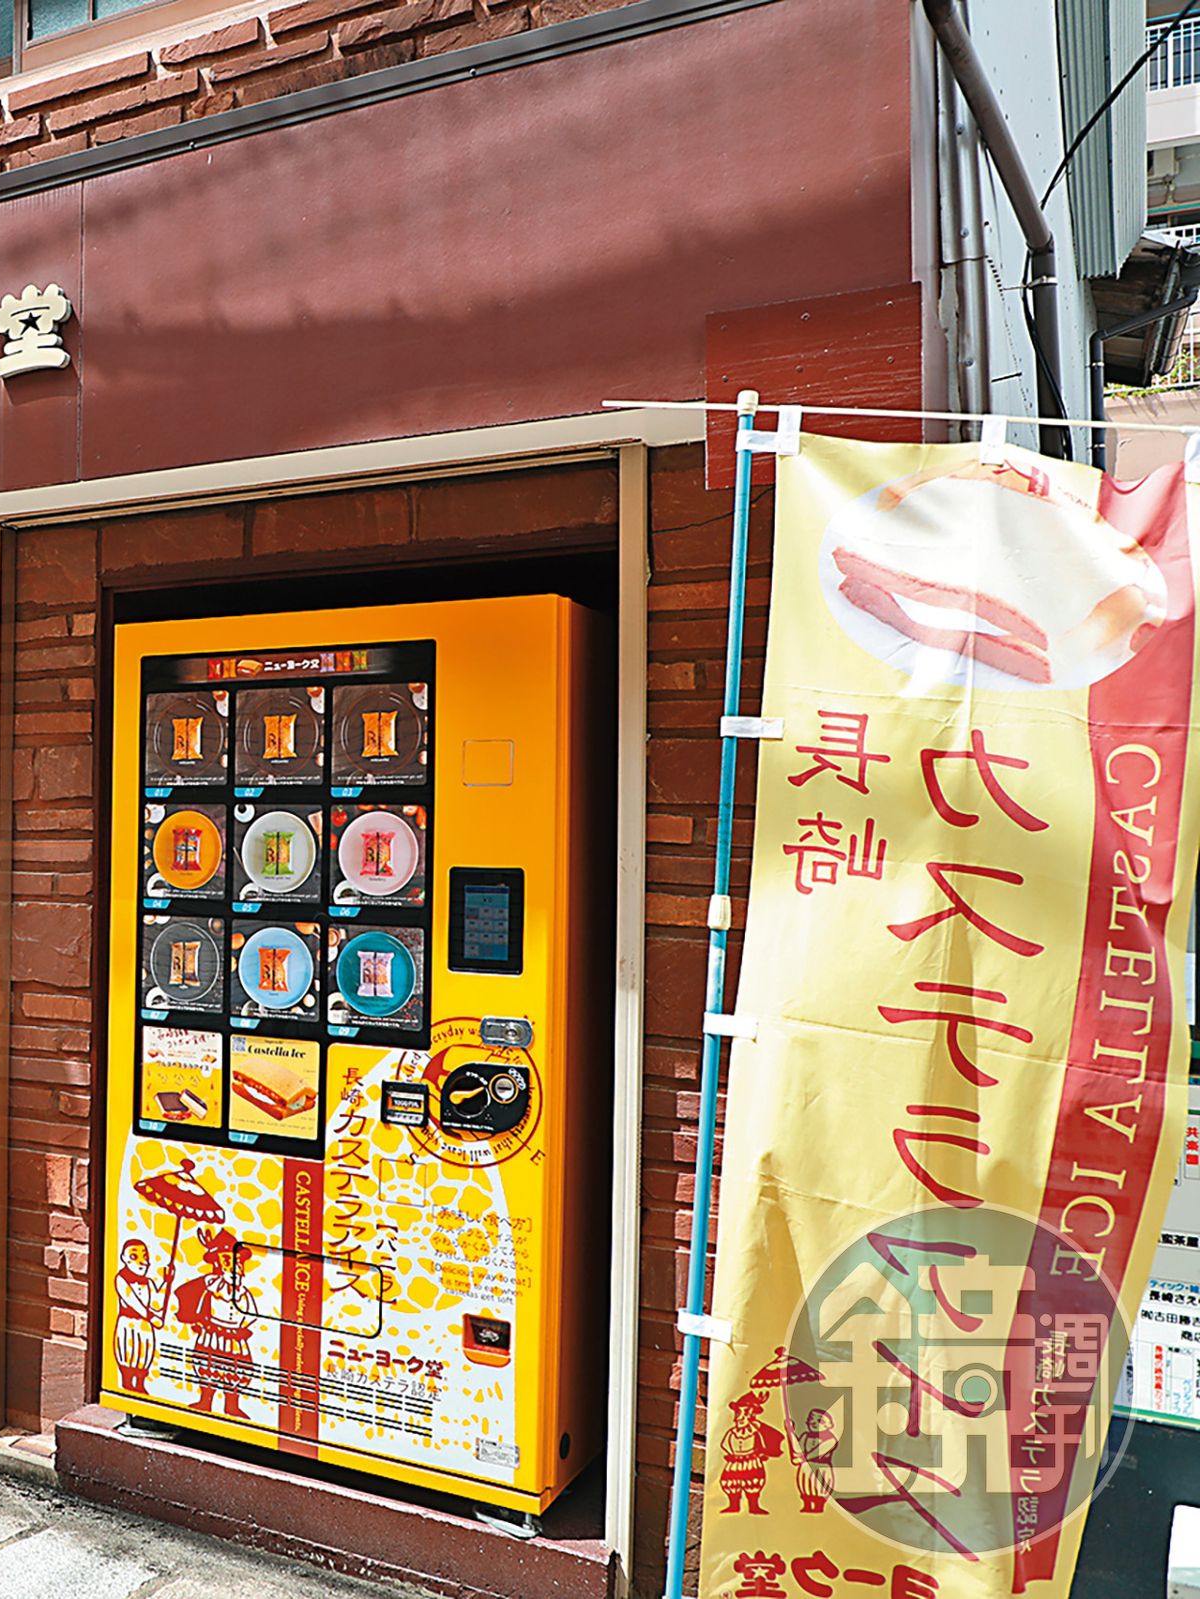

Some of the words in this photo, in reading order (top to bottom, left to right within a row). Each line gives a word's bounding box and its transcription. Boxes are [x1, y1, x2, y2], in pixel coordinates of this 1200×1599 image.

[248, 1044, 290, 1058] Castella
[295, 1261, 311, 1292] ICE
[1149, 1290, 1200, 1306] 長崎さえ
[328, 1339, 444, 1379] ニューヨーク堂
